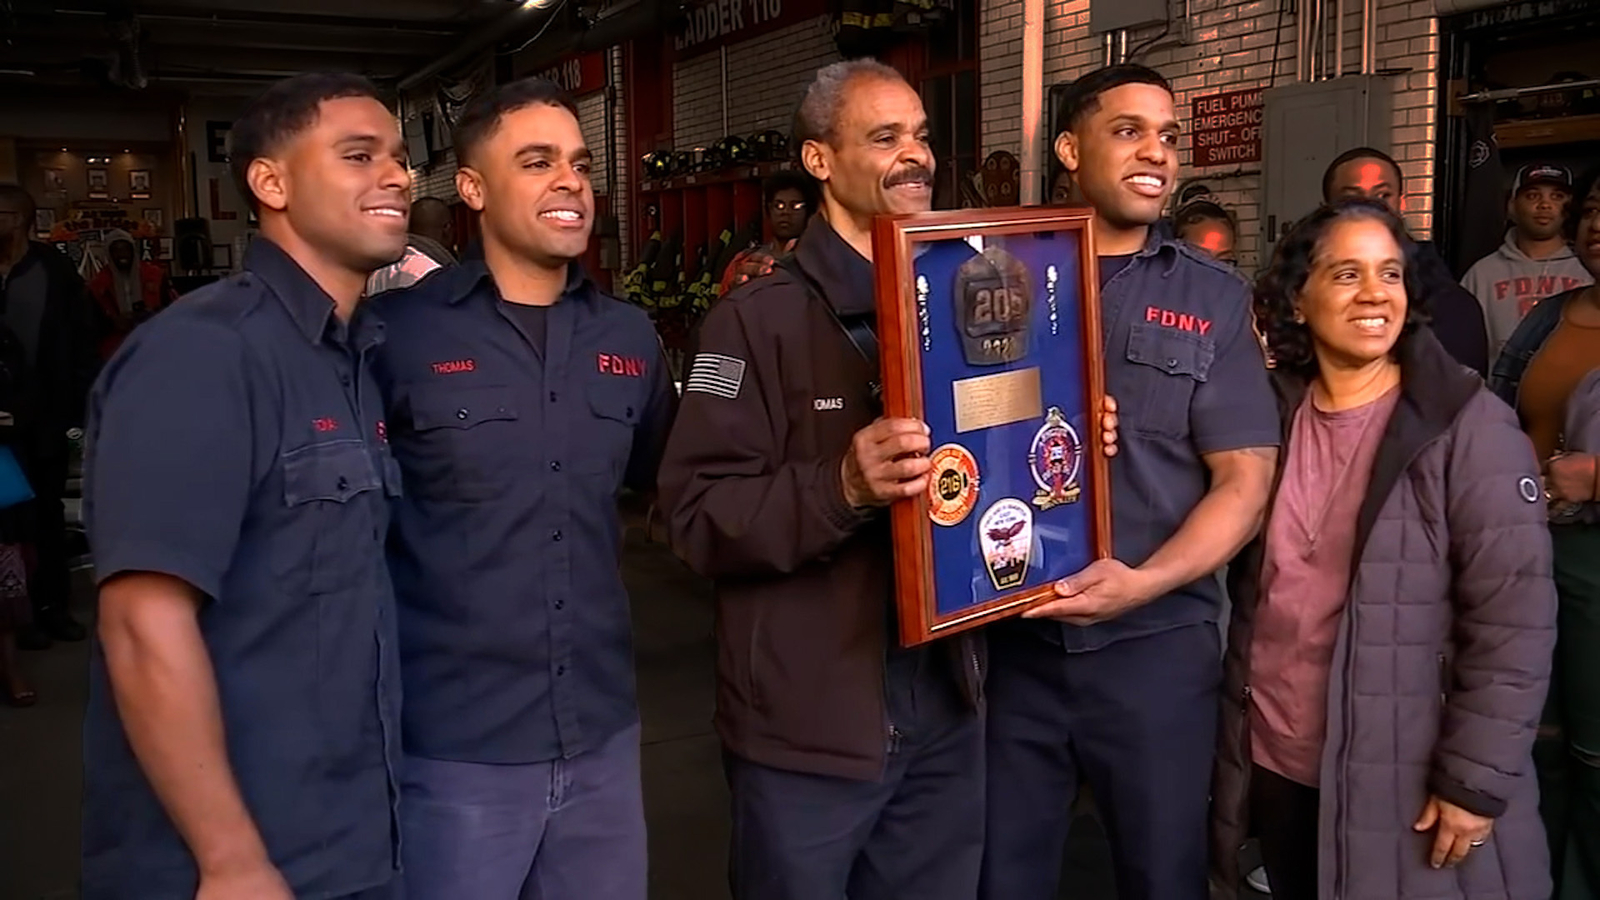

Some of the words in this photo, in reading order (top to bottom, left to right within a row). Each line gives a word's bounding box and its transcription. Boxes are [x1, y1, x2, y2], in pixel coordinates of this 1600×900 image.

[562, 58, 582, 91] 118
[1197, 98, 1227, 115] FUEL
[1194, 109, 1263, 131] EMERGENC
[1209, 144, 1256, 161] SWITCH
[1146, 306, 1213, 335] FDNY
[431, 359, 477, 374] THOMAS
[598, 353, 647, 377] FDNY
[941, 474, 961, 494] 216
